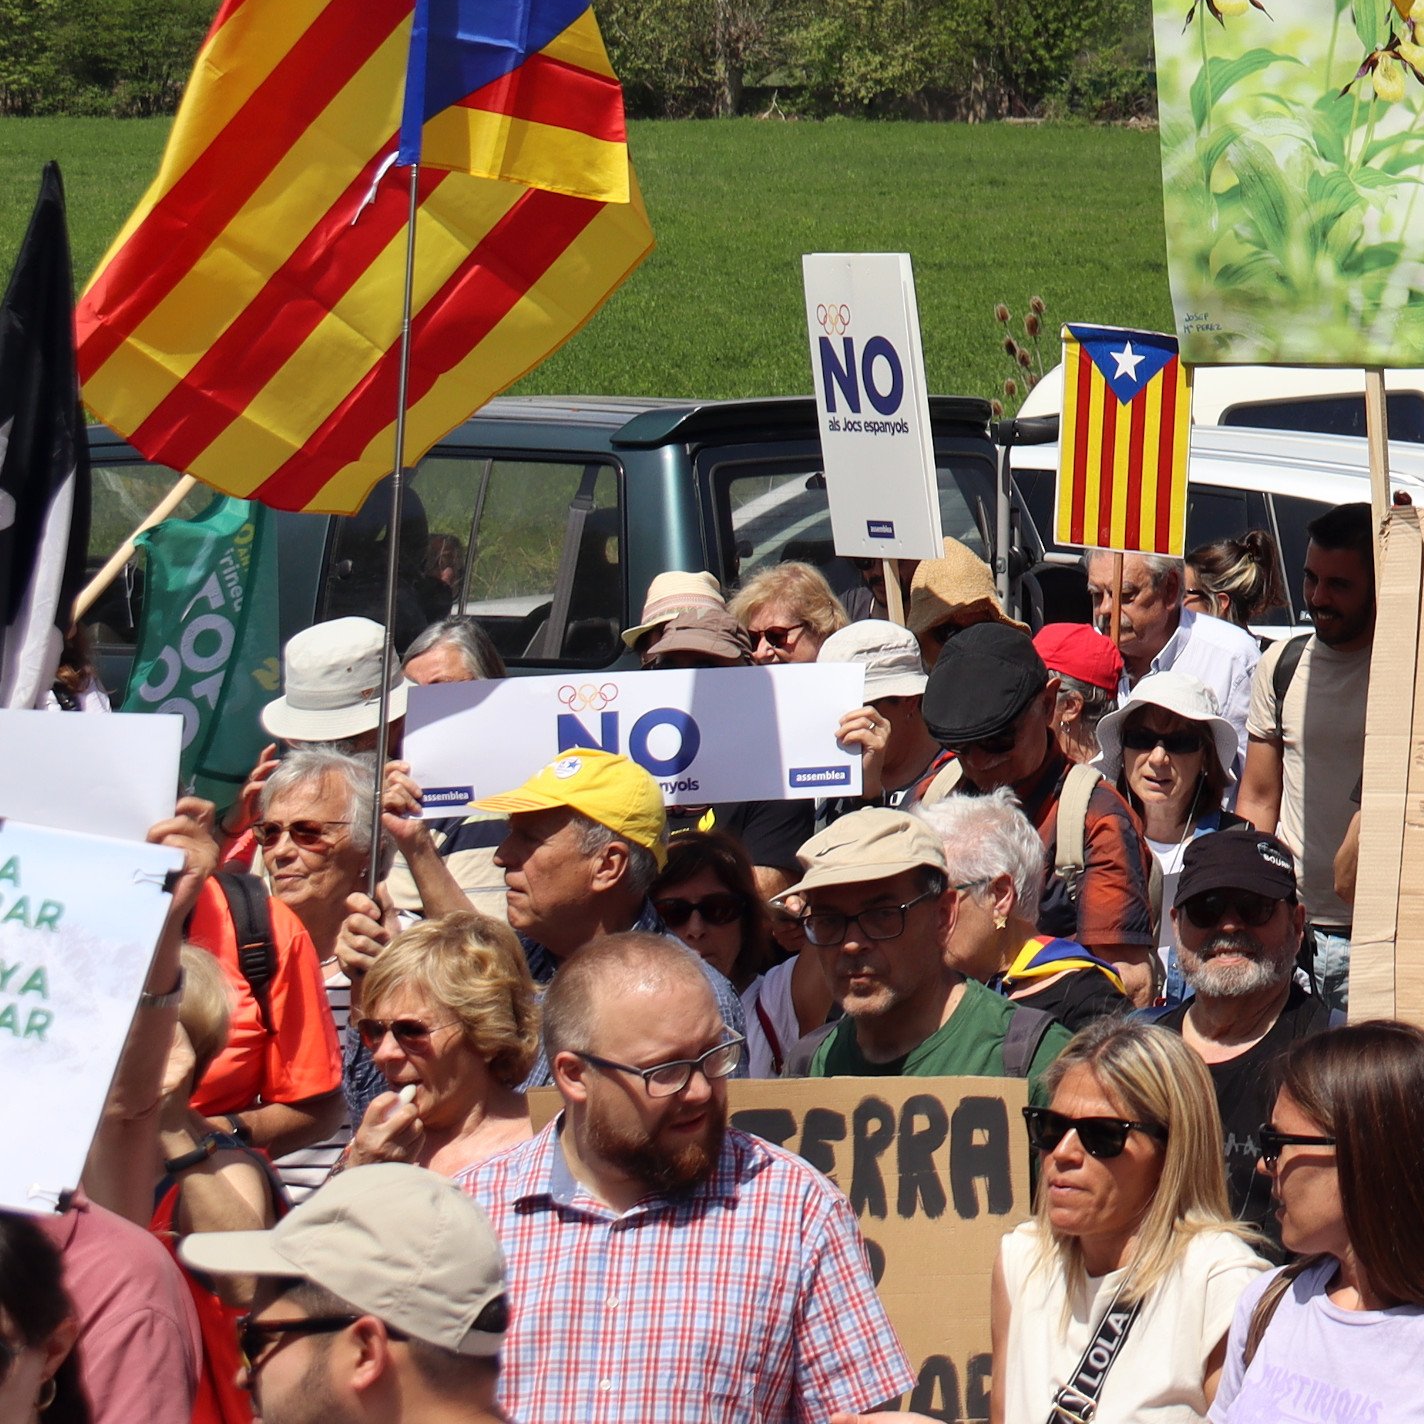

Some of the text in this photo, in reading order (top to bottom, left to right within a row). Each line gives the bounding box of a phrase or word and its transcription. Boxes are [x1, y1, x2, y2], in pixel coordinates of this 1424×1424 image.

[819, 336, 904, 415] NO
[829, 418, 909, 437] als Jocs espanyols
[557, 707, 701, 777] NO
[796, 770, 846, 782] assemblea
[1077, 1313, 1130, 1388] LOLA
